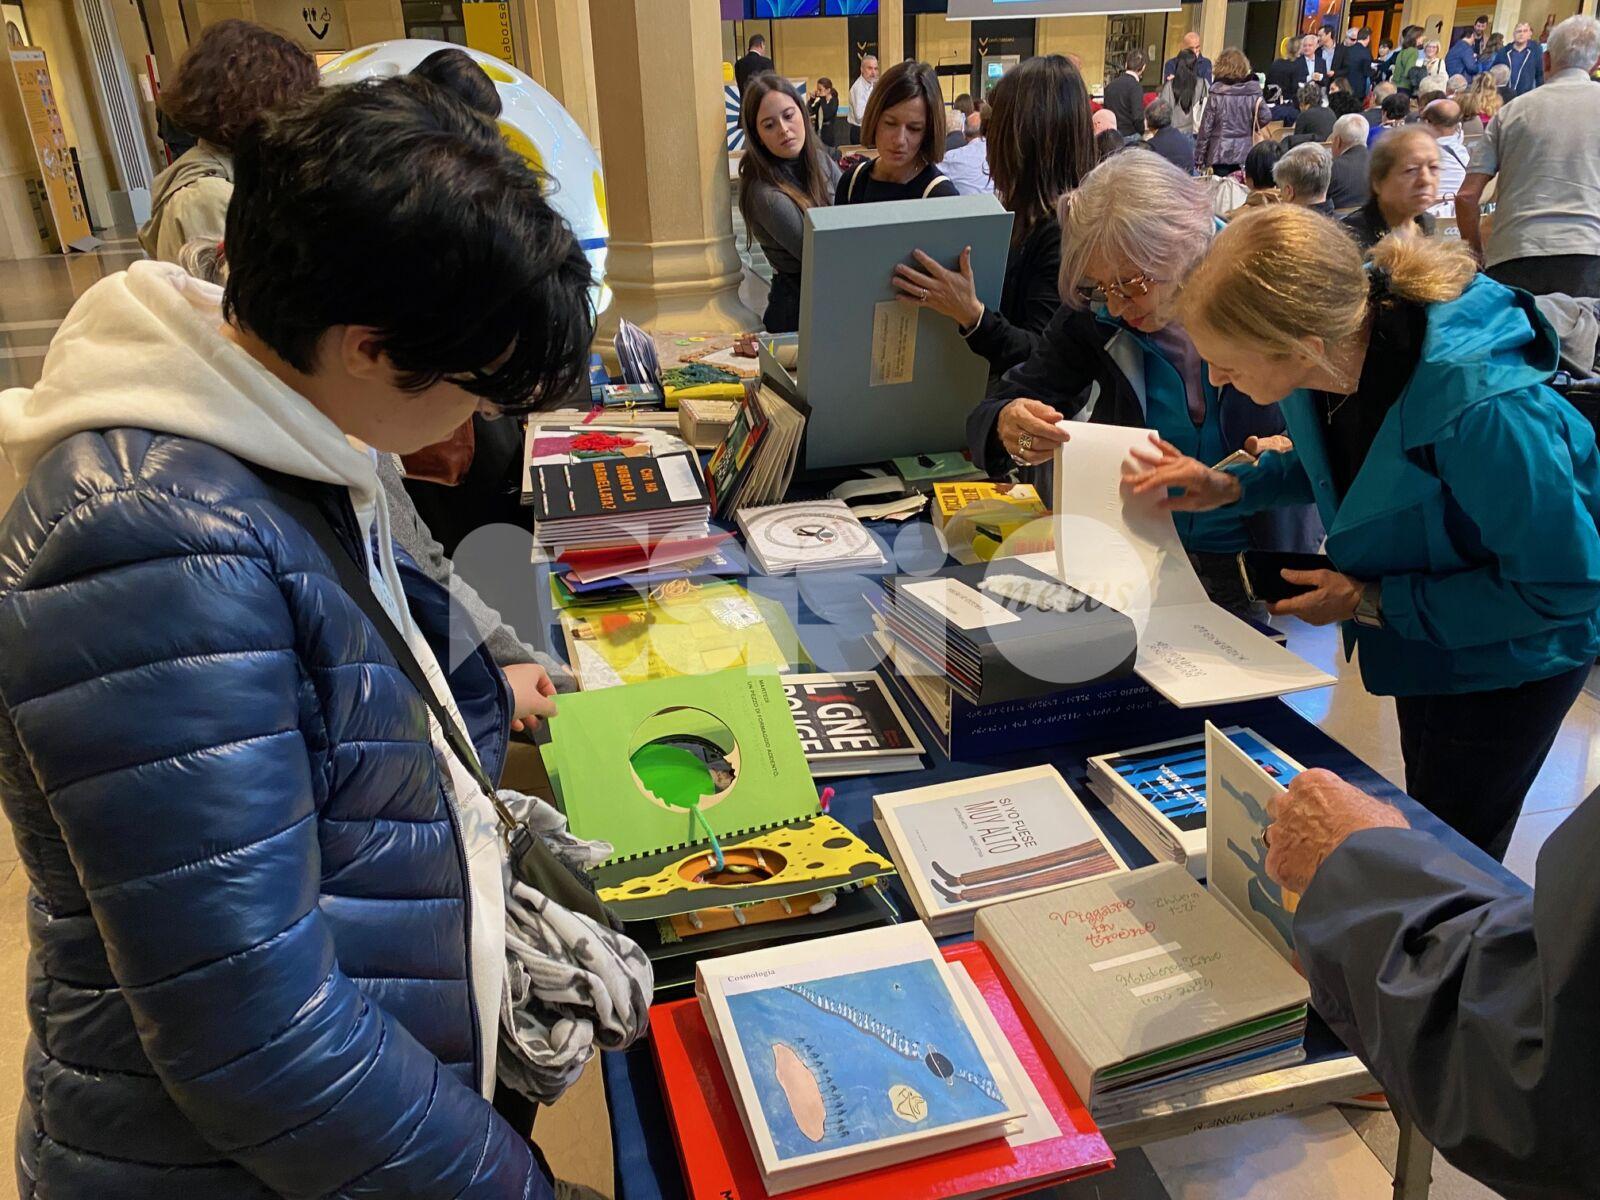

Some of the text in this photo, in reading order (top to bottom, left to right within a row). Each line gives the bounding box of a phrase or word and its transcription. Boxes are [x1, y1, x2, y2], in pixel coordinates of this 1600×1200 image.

[615, 464, 637, 502] RUBATO LA
[644, 482, 659, 493] HA
[852, 681, 870, 692] LA
[1005, 806, 1020, 819] YO
[964, 800, 1021, 854] MUY ALTO
[1012, 820, 1037, 848] FUESE
[727, 969, 776, 982] Cosmologia
